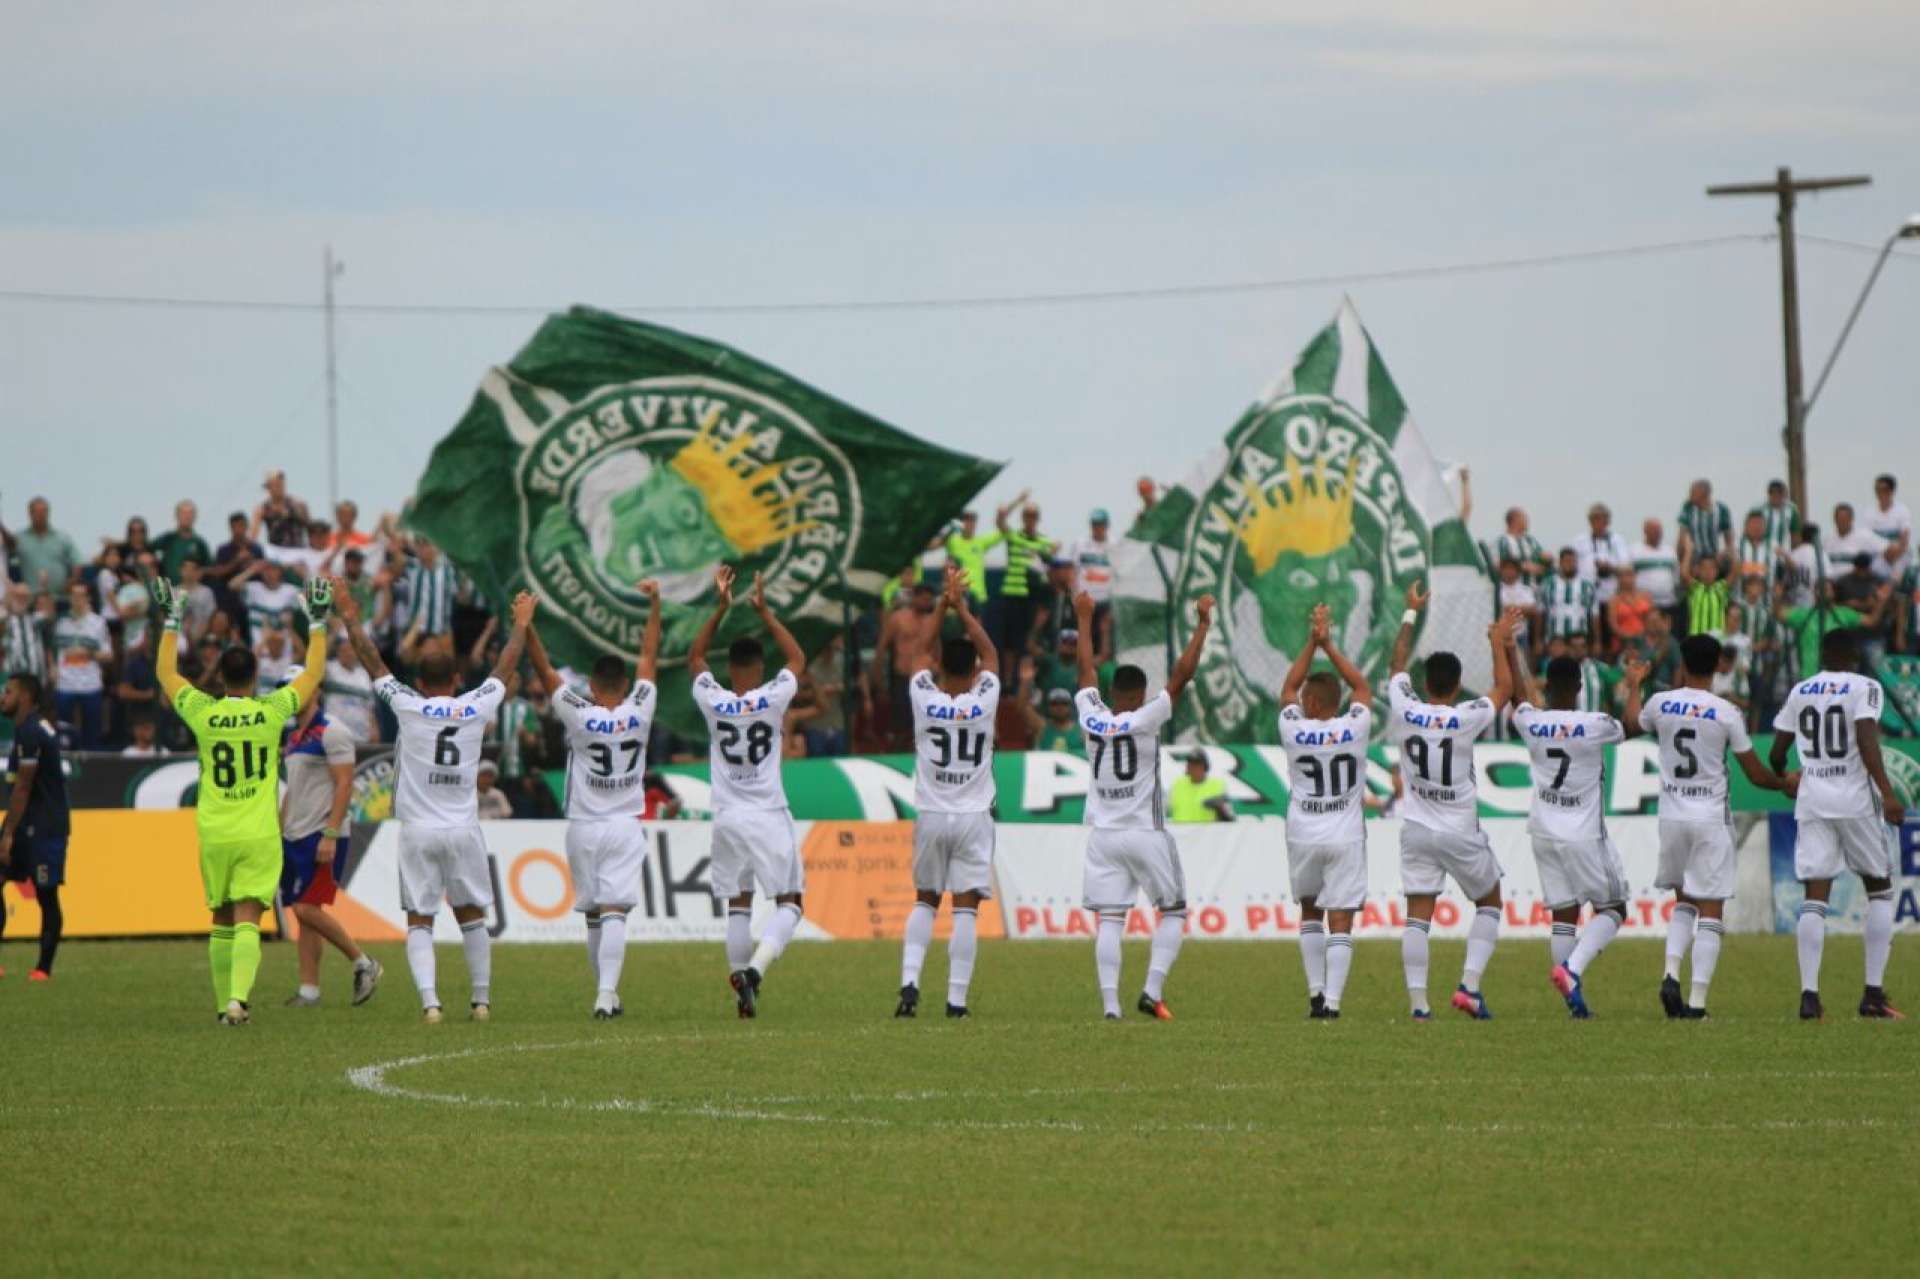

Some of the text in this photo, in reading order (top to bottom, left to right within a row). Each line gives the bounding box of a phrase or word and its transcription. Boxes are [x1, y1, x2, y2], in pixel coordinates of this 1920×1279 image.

[713, 696, 769, 716] CAIXA
[1799, 682, 1850, 695] CAIXA
[208, 711, 266, 728] CAIXA
[422, 705, 477, 720] CAIXA
[586, 715, 640, 735] CAIXA
[926, 704, 983, 720] CAIXA
[1404, 711, 1459, 730] CAIXA
[1661, 701, 1717, 720] CAIXA
[435, 726, 460, 766] 6
[716, 720, 773, 766] 28
[926, 726, 986, 768] 34
[1295, 729, 1353, 746] CAIXA
[1529, 724, 1585, 741] CAIXA
[1799, 705, 1849, 759] 90
[212, 740, 268, 788] 84
[587, 738, 643, 777] 37
[1089, 733, 1138, 781] 70
[1405, 735, 1454, 786] 91
[1546, 748, 1571, 789] 7
[1673, 728, 1698, 778] 5
[1296, 753, 1357, 797] 30
